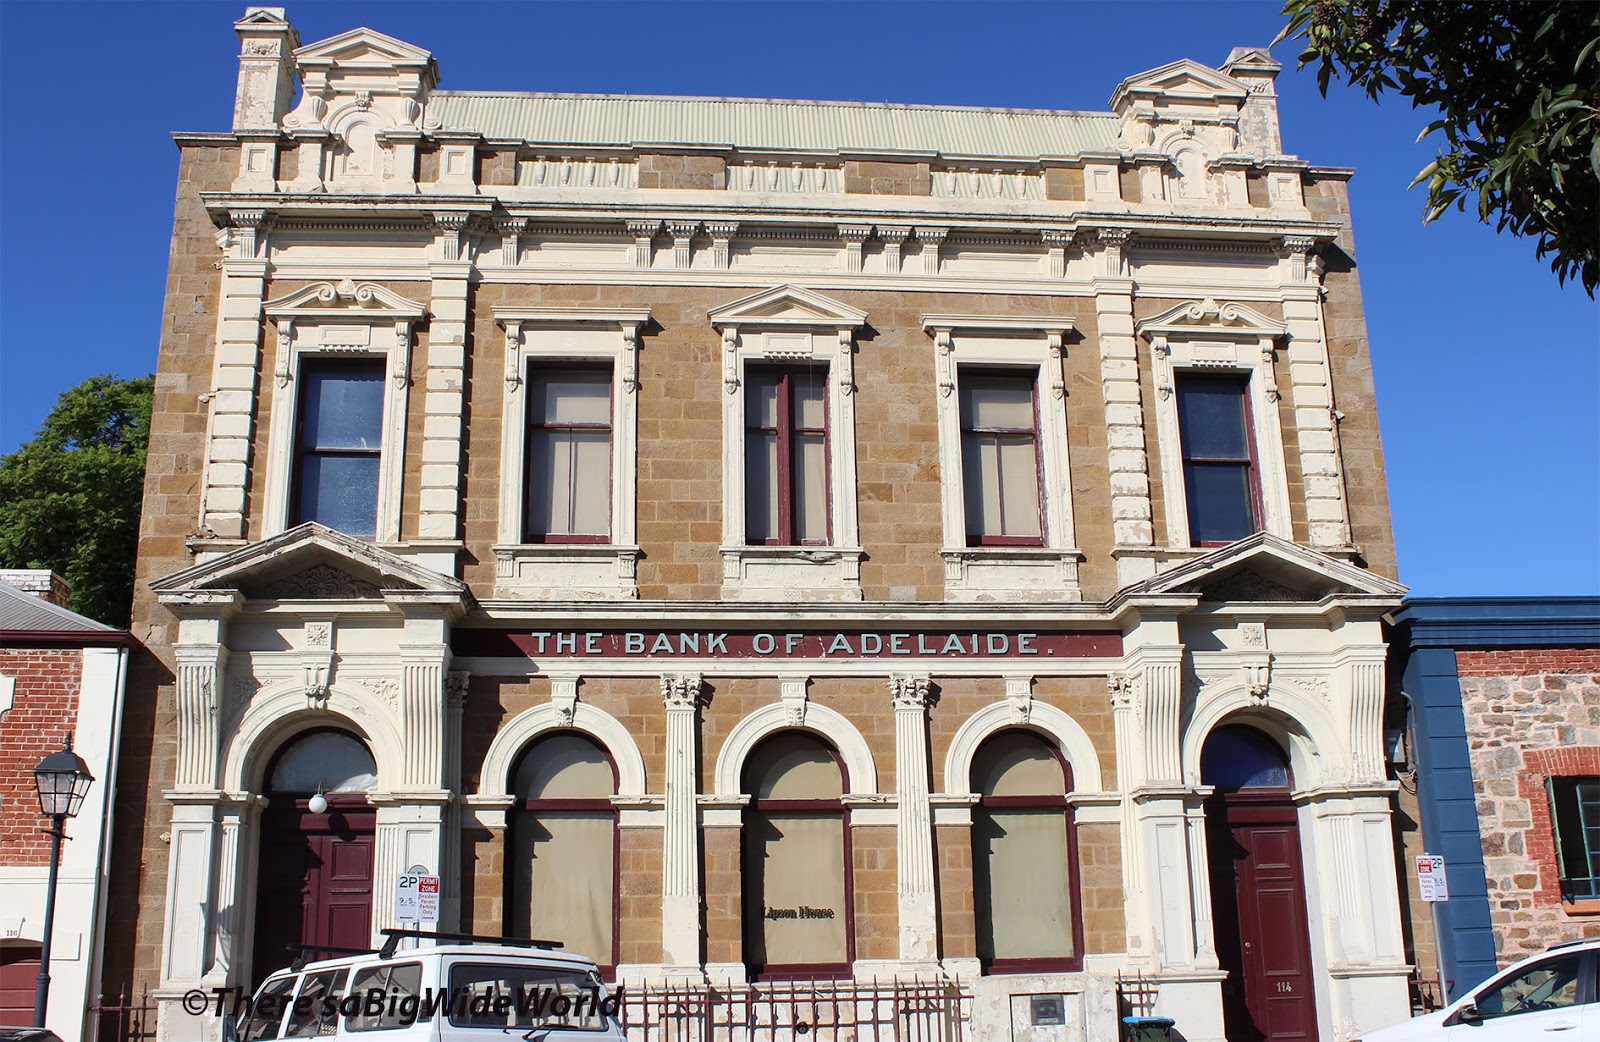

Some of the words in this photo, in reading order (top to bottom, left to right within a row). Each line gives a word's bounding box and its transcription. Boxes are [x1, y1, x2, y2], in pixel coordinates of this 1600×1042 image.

[531, 632, 604, 655] THE
[624, 632, 729, 655] BANK
[752, 633, 805, 655] OF
[827, 633, 1055, 656] ADELAIDE.
[1431, 858, 1442, 868] 2P
[400, 876, 418, 888] 2P
[798, 906, 834, 919] House
[1276, 982, 1292, 992] 114
